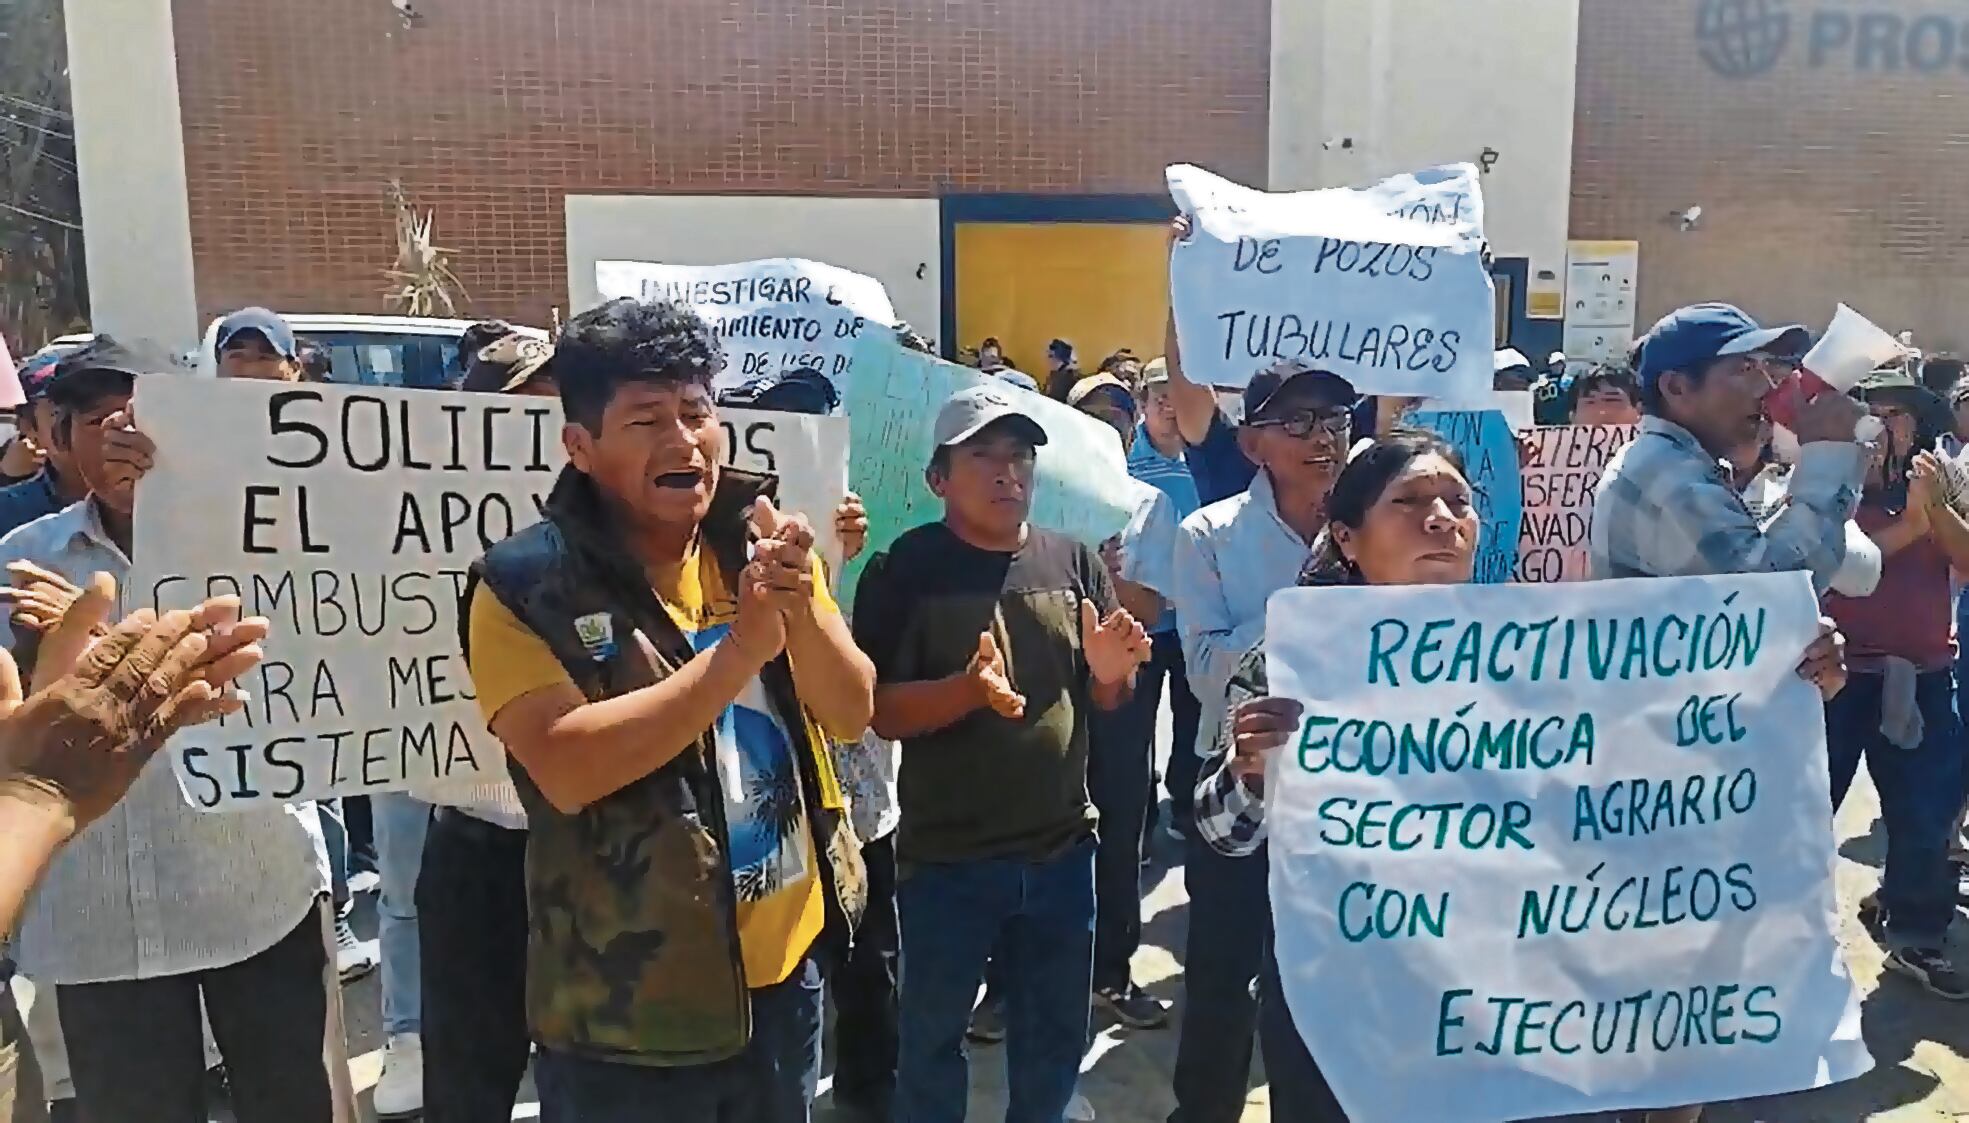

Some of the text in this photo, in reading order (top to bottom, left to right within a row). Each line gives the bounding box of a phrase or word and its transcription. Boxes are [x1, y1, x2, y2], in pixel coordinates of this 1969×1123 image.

[1234, 236, 1437, 282] DE POZOS
[1217, 310, 1461, 373] TUBULARES
[242, 485, 331, 554] EL
[1367, 591, 1766, 687] REACTIVACIÓN
[182, 721, 480, 808] SISTEMA
[1298, 692, 1747, 774] ECONÓMICA DEL
[1318, 768, 1757, 851] SECTOR AGRARIO
[1338, 863, 1757, 943] CON NÚCLEOS
[1436, 984, 1782, 1057] EJECUTORES
